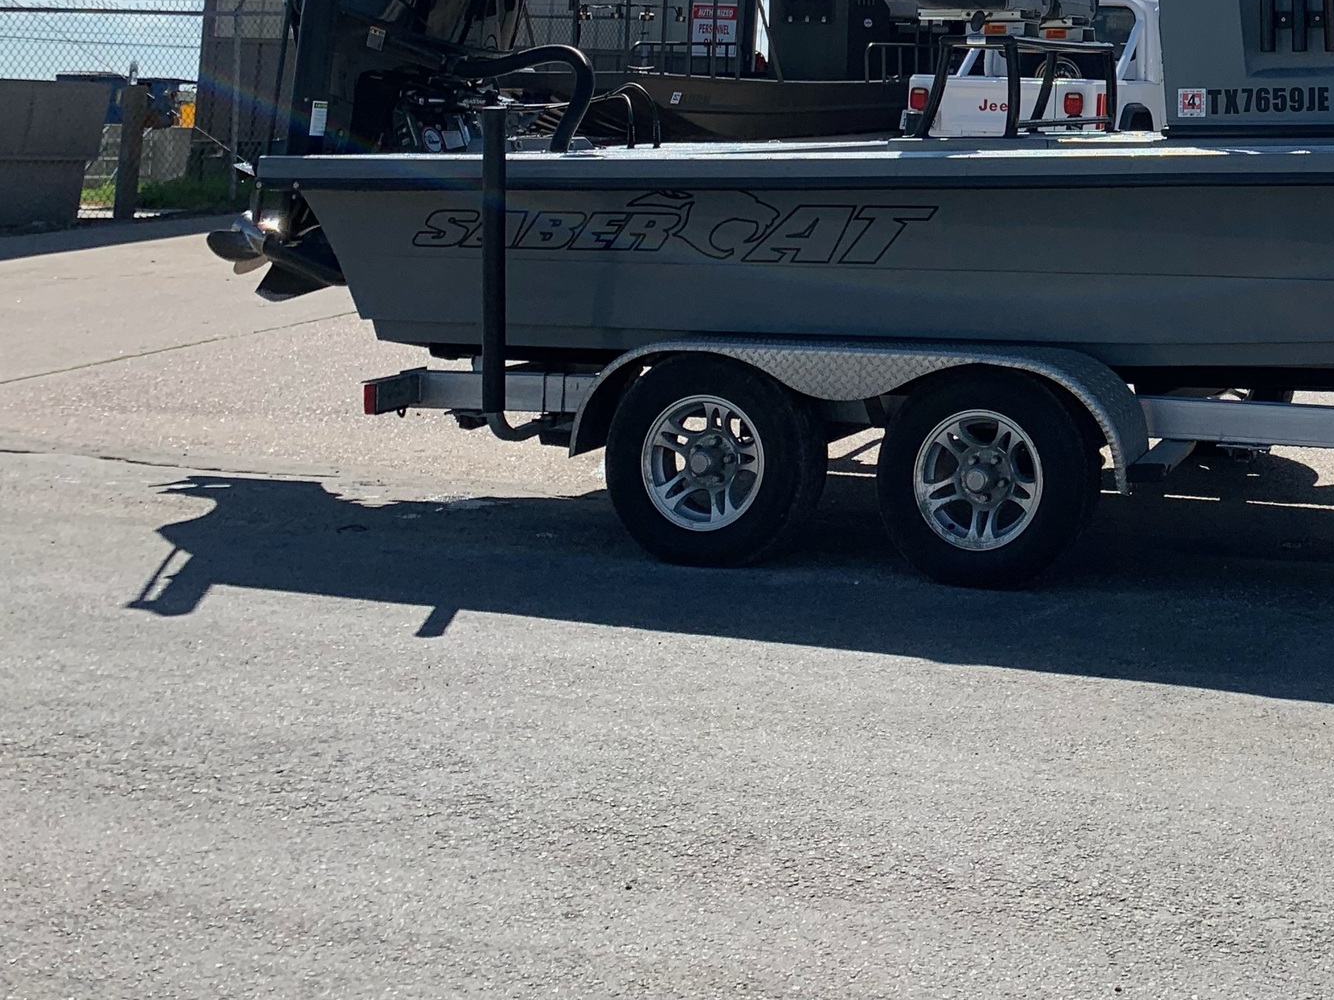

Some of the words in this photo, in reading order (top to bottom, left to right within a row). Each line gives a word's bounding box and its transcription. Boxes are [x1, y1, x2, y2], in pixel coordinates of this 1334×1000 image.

[698, 8, 734, 18] AUTHRIZED
[698, 23, 730, 35] PERSNNEL
[978, 99, 1009, 112] Jee
[1187, 94, 1197, 110] 4
[1207, 86, 1330, 115] TX7659JE
